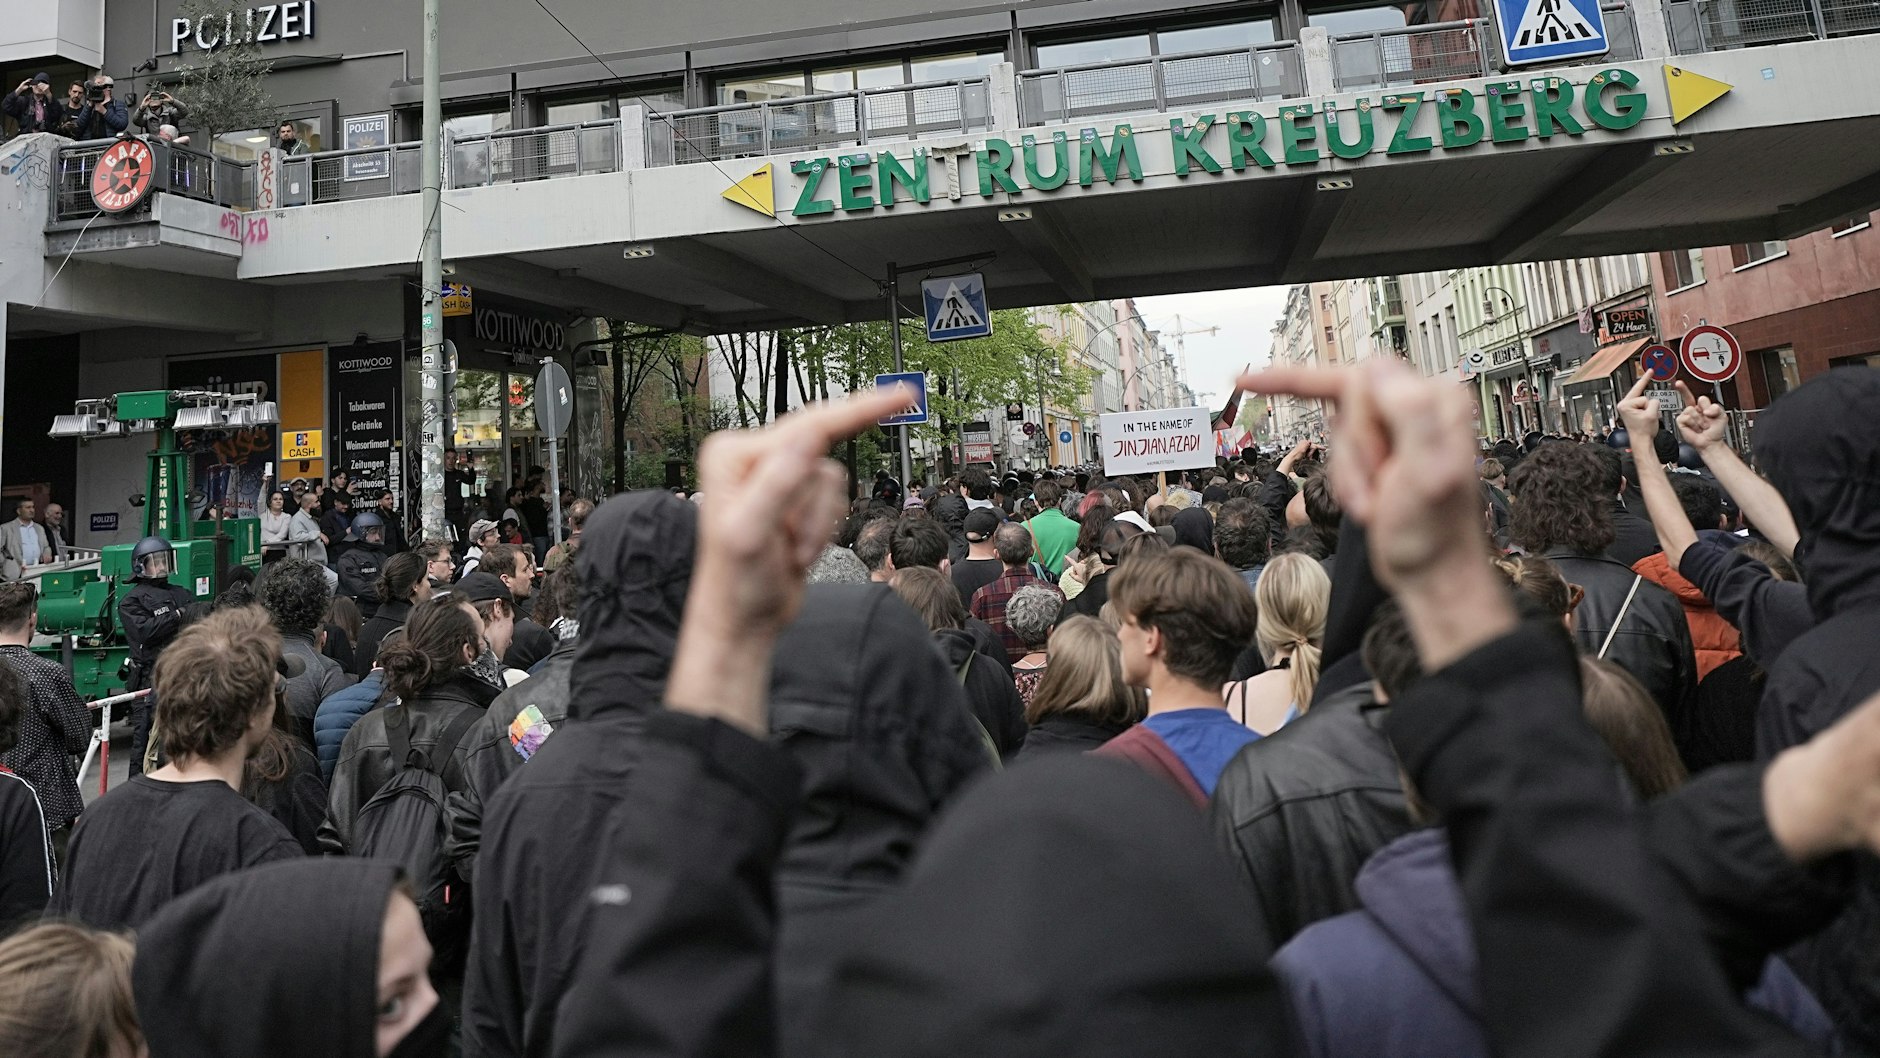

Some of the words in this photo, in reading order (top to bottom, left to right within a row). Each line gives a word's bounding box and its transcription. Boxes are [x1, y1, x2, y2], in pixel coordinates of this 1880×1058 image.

[172, 0, 313, 53] POLIZEI
[349, 121, 384, 134] POLIZEI
[790, 124, 1143, 217] ZENTRUM
[1169, 69, 1647, 177] KREUZBERG
[104, 143, 148, 168] CAFÉ
[101, 186, 139, 207] KOTTI
[442, 301, 457, 309] SH
[1610, 310, 1645, 322] OPEN
[475, 307, 564, 351] KOTTIWOOD
[1613, 322, 1624, 333] 24
[1626, 321, 1647, 332] Hours
[339, 357, 393, 369] KOTTIWOOD
[348, 400, 386, 412] Tabakwaren
[352, 419, 383, 431] Getränke
[1123, 423, 1135, 433] IN
[1137, 421, 1157, 432] THE
[1160, 419, 1182, 430] NAME
[1183, 418, 1194, 429] OF
[345, 439, 390, 450] Weinsortiment
[289, 447, 315, 457] CASH
[351, 460, 385, 470] Zeitungen
[357, 479, 386, 488] irituosen
[158, 457, 168, 530] LEHMANN
[351, 496, 379, 508] Süßwar
[93, 515, 116, 523] POLIZEI
[242, 554, 260, 562] LEHMANN
